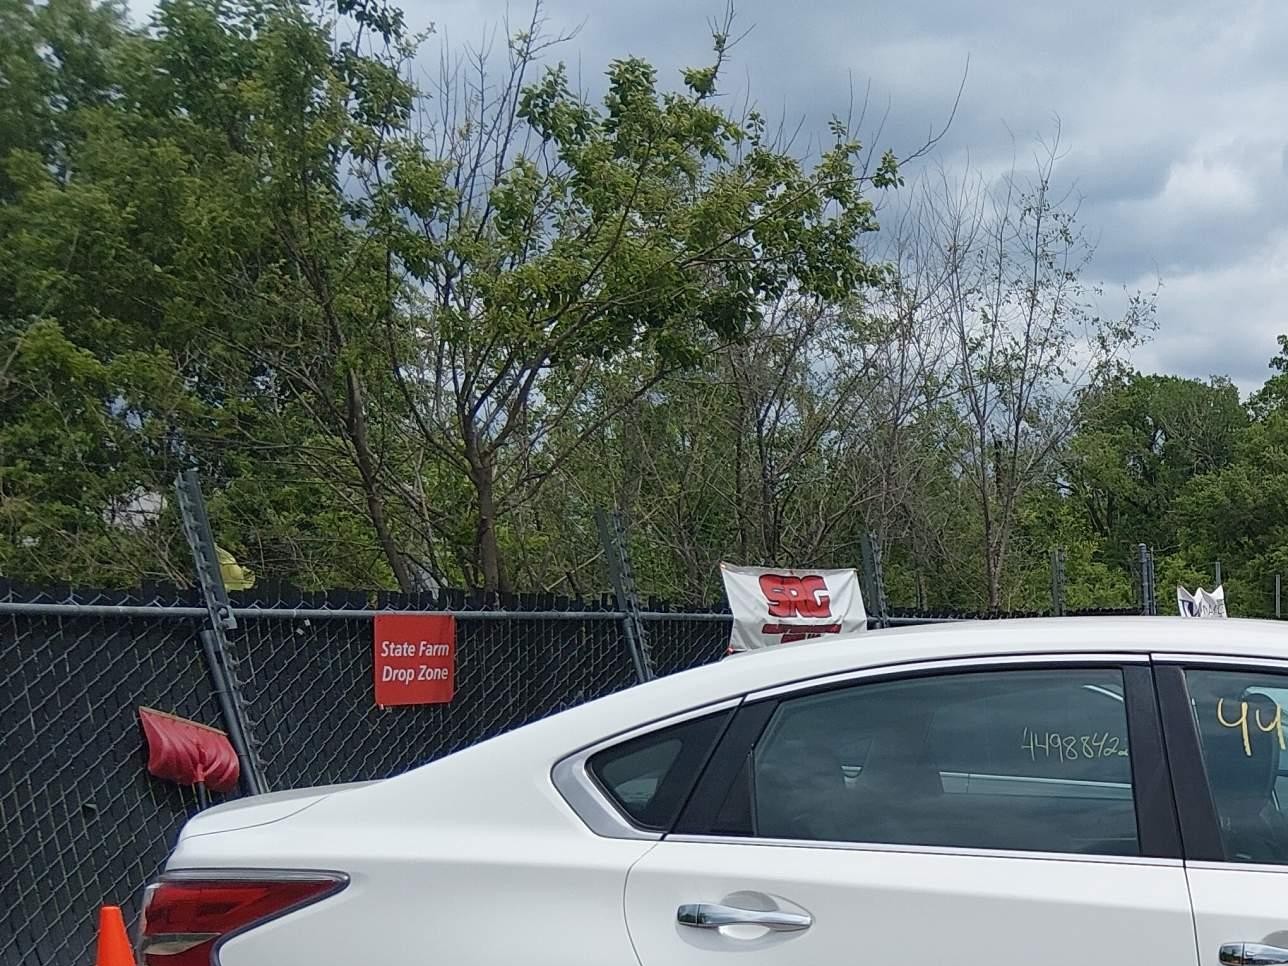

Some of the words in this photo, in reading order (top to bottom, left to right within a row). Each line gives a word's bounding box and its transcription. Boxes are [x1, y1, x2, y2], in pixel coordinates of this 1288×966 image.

[758, 574, 832, 618] SRG
[381, 641, 416, 657] State
[419, 641, 449, 656] Farm
[382, 665, 415, 685] Drop
[418, 665, 449, 681] Zone
